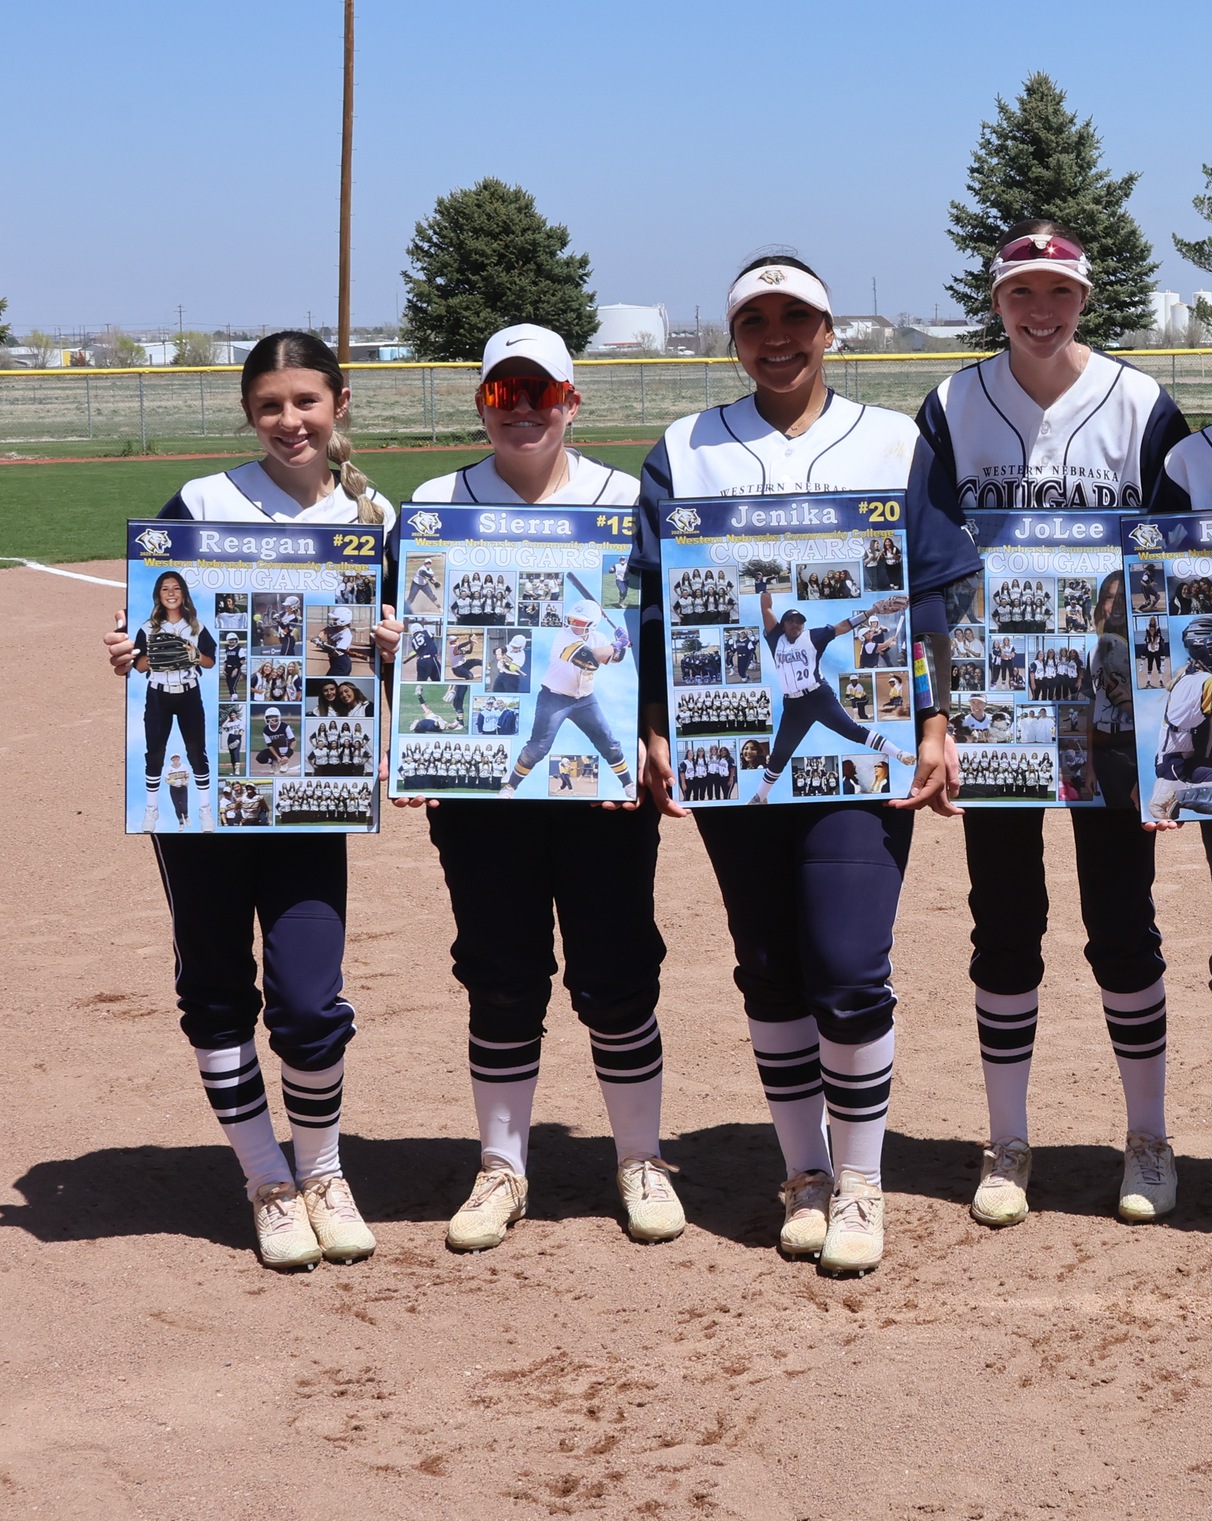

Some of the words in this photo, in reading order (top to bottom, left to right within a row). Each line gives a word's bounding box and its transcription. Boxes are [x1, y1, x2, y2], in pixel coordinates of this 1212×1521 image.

[982, 465, 1044, 478] WESTERN
[1052, 465, 1120, 482] NEBRASKA
[719, 482, 786, 497] WESTERN
[730, 503, 838, 528] Jenika
[858, 501, 901, 523] #20
[478, 512, 572, 536] Sierra
[596, 514, 637, 536] #15
[1014, 517, 1105, 539] JoLee
[198, 530, 316, 560] Reagan
[332, 533, 376, 557] #22
[414, 537, 462, 547] Western
[465, 538, 518, 549] Nebraska
[522, 540, 585, 551] Community
[588, 541, 630, 552] College
[675, 535, 723, 545] Western
[726, 533, 781, 544] Nebraska
[783, 531, 848, 542] Community
[851, 528, 895, 540] College
[709, 537, 866, 565] COUGARS
[977, 545, 999, 553] tern
[1002, 544, 1055, 553] Nebraska
[1138, 551, 1186, 560] Western
[144, 557, 194, 568] Western
[197, 558, 253, 569] Nebraska
[256, 561, 322, 572] Community
[325, 561, 370, 572] College
[447, 546, 602, 569] COUGARS
[985, 552, 1123, 574] COUGAR
[180, 568, 340, 592] COUGARS
[412, 633, 425, 650] 15
[796, 668, 810, 682] 20
